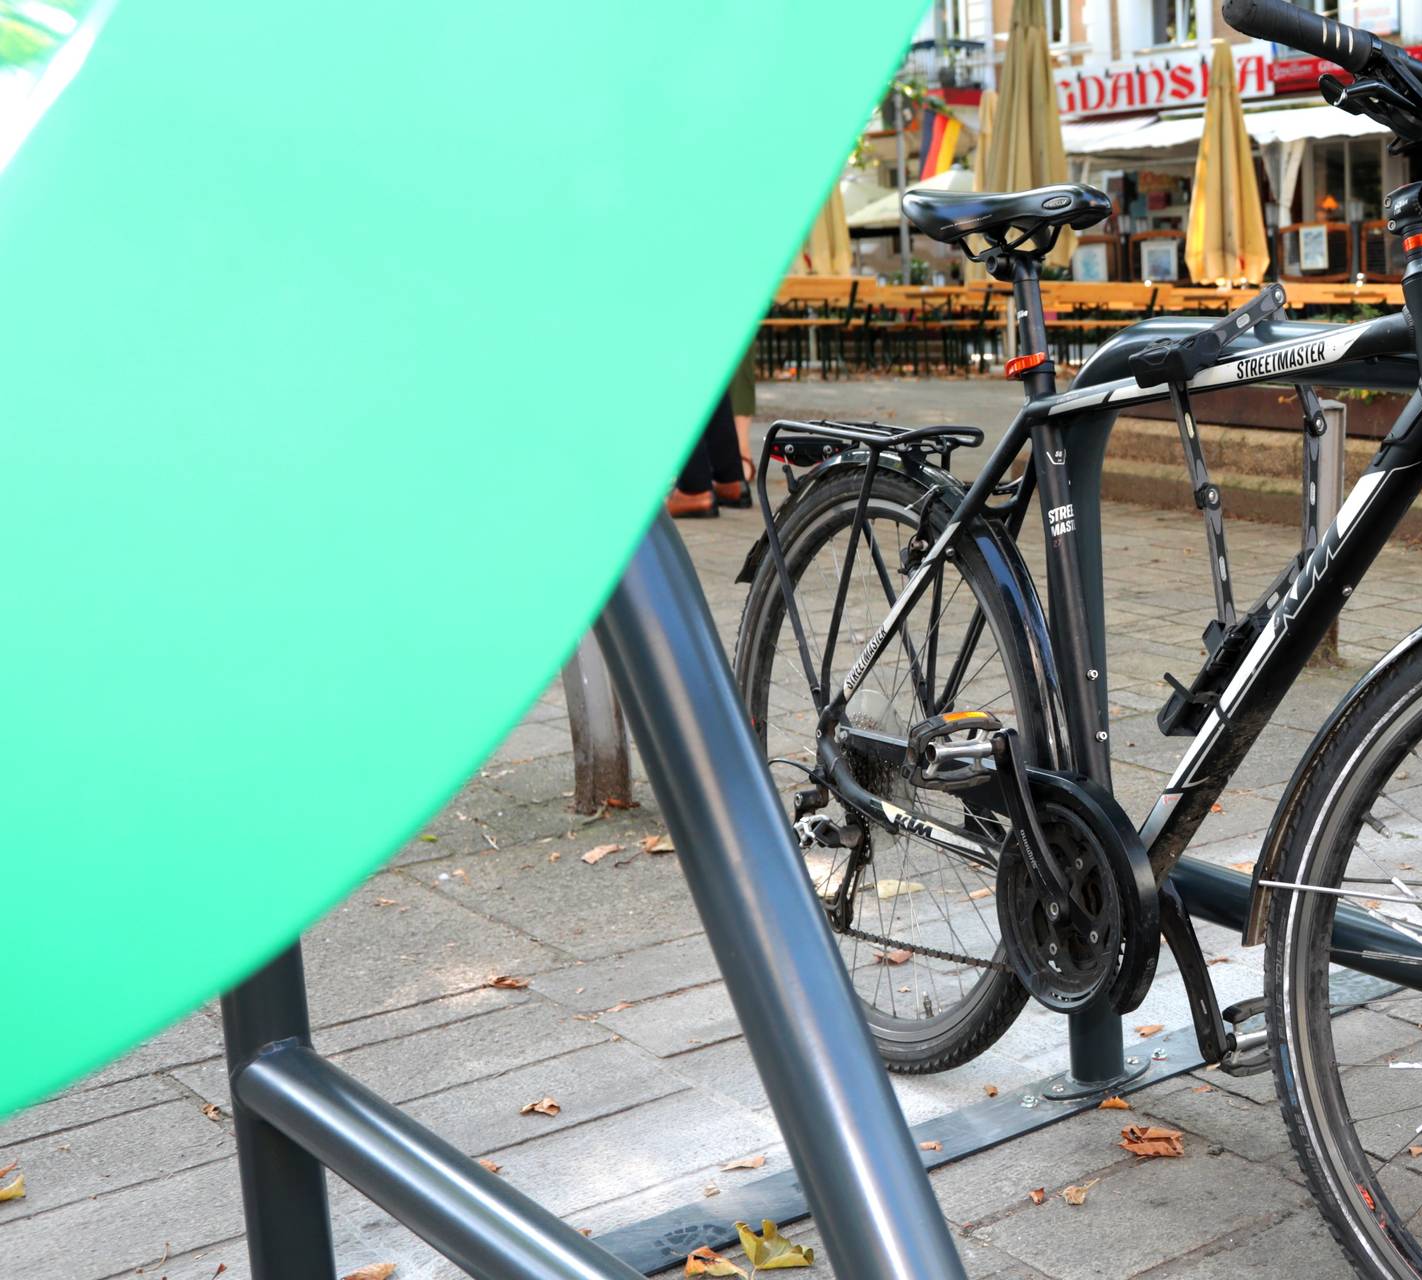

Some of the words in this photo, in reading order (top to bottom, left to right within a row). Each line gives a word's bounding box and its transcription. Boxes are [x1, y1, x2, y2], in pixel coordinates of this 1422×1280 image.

[1056, 54, 1265, 114] GDANSA
[1236, 340, 1326, 379] STREETMASTER
[1050, 519, 1076, 537] MAST
